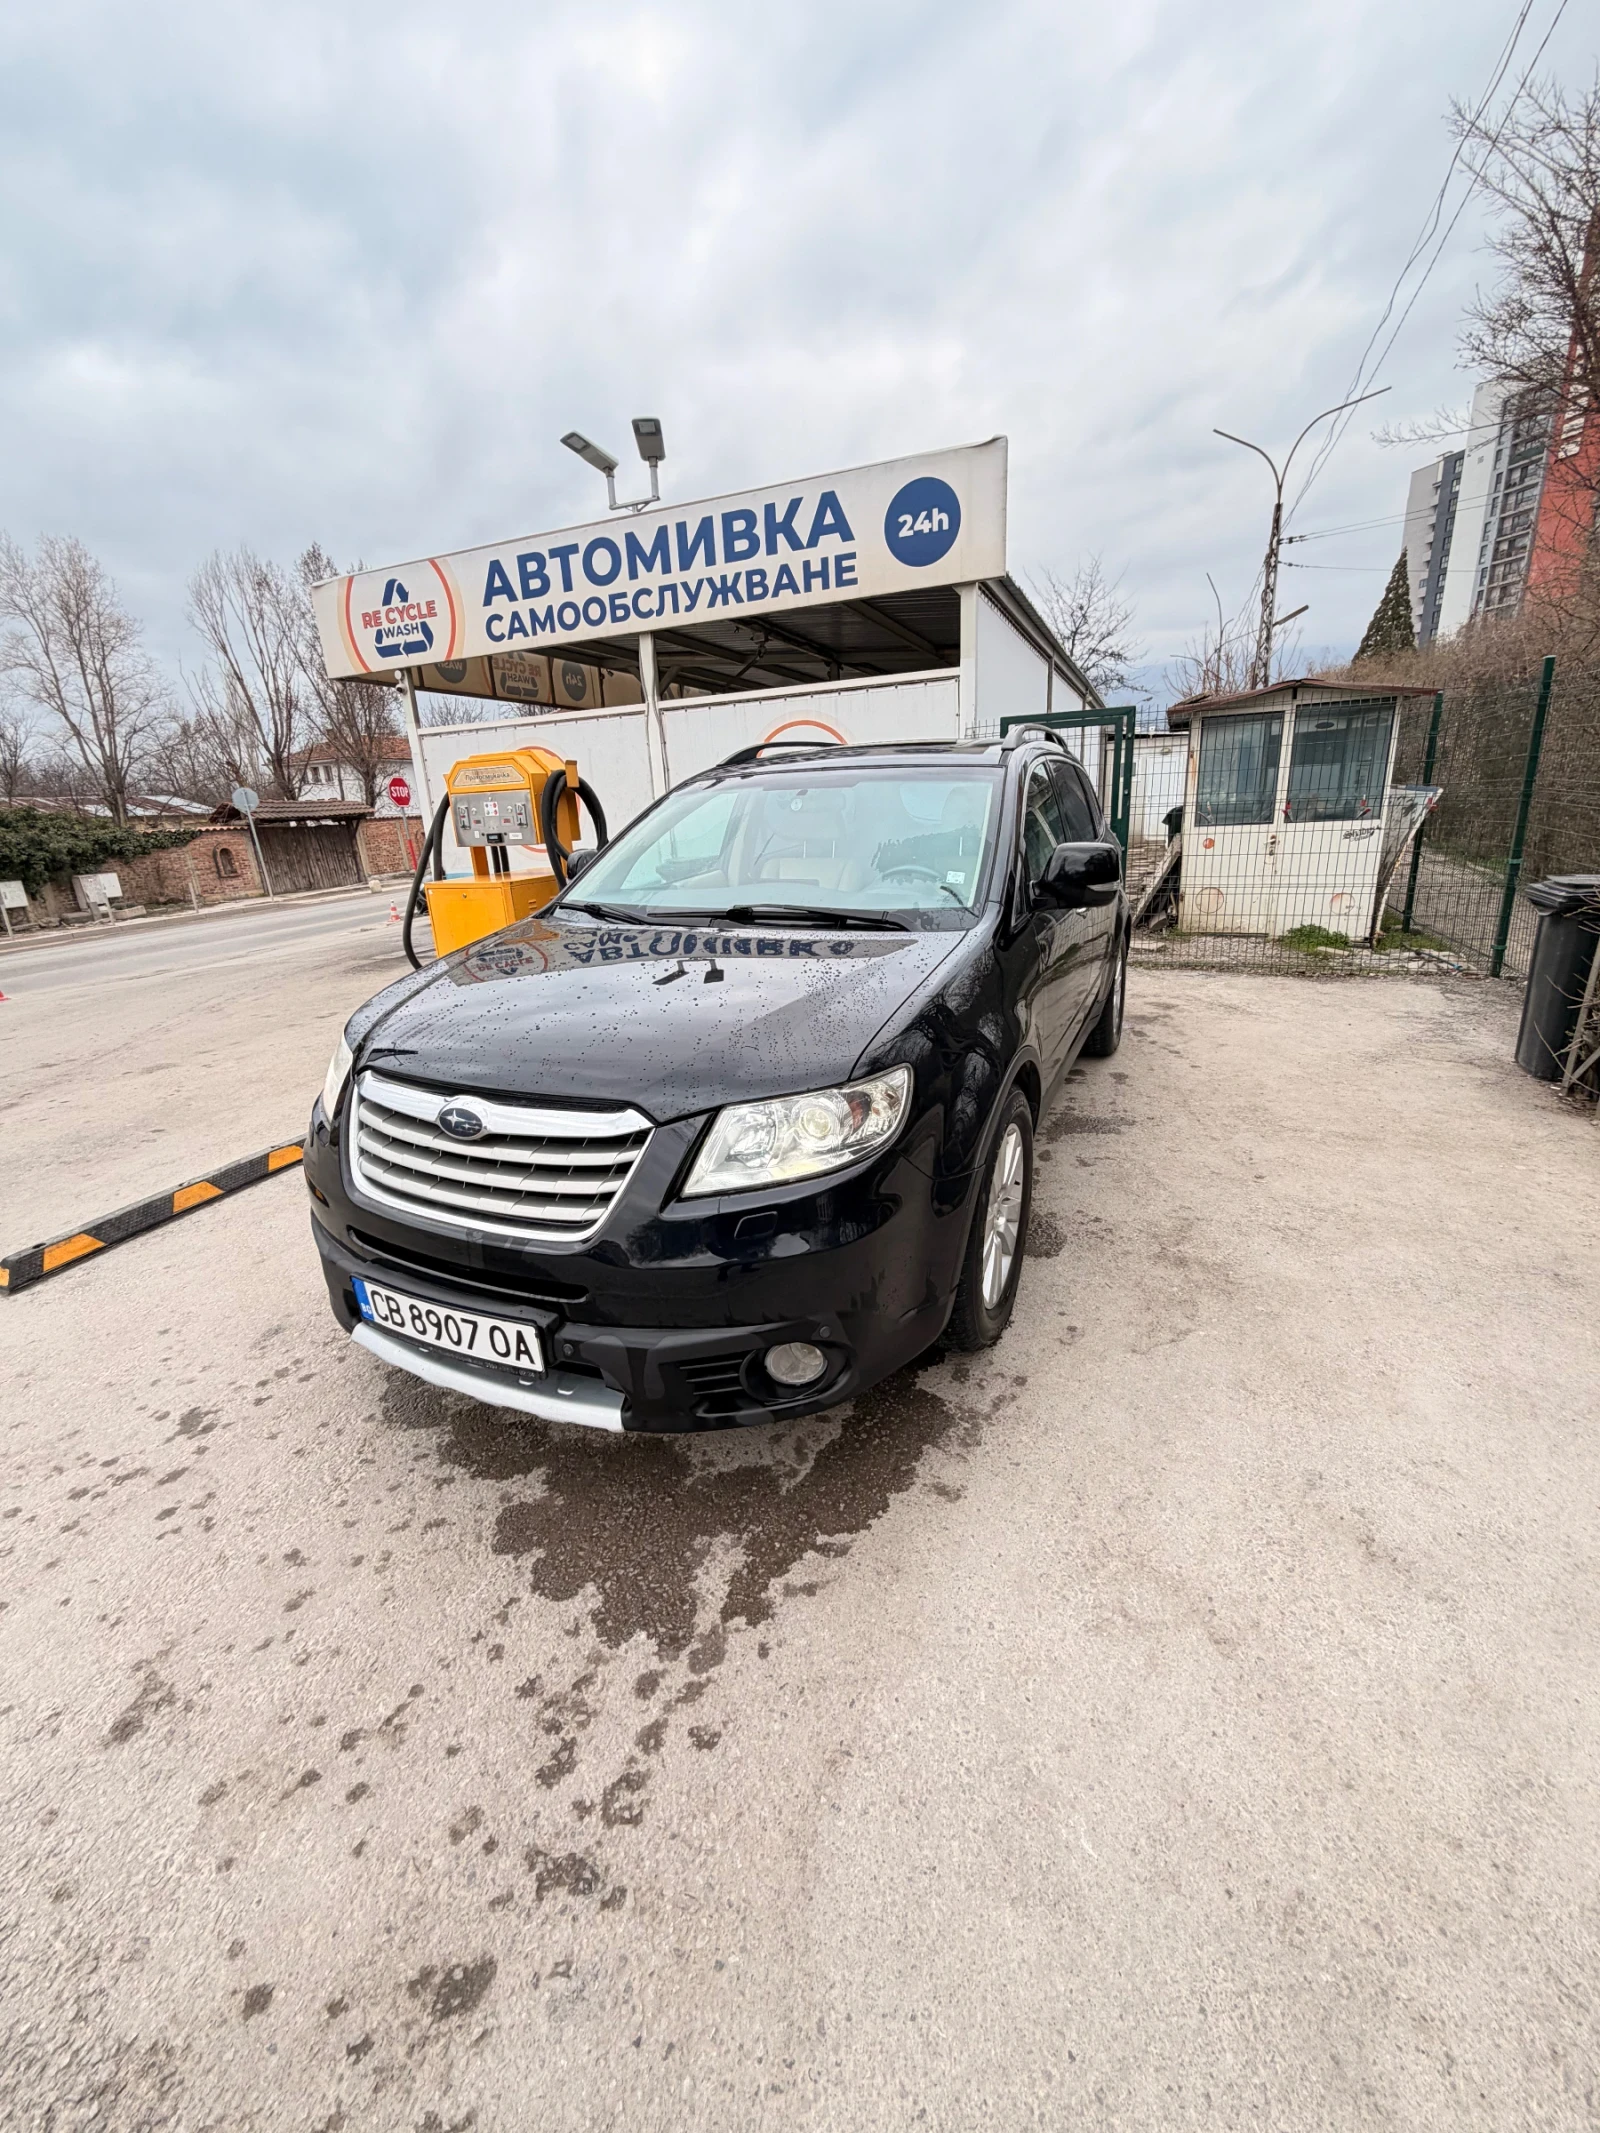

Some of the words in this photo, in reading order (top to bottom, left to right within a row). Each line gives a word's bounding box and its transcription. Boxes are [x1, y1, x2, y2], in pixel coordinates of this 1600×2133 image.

[898, 507, 949, 538] 24h
[482, 490, 855, 606] АВТОМИВКА
[485, 552, 859, 643] САМООБСЛУЖВАНЕ
[361, 609, 382, 629] RE
[385, 600, 437, 624] CYCLE
[383, 622, 419, 638] WASH
[391, 786, 409, 798] STOP
[360, 1302, 372, 1314] BG
[408, 1303, 478, 1350] 8907
